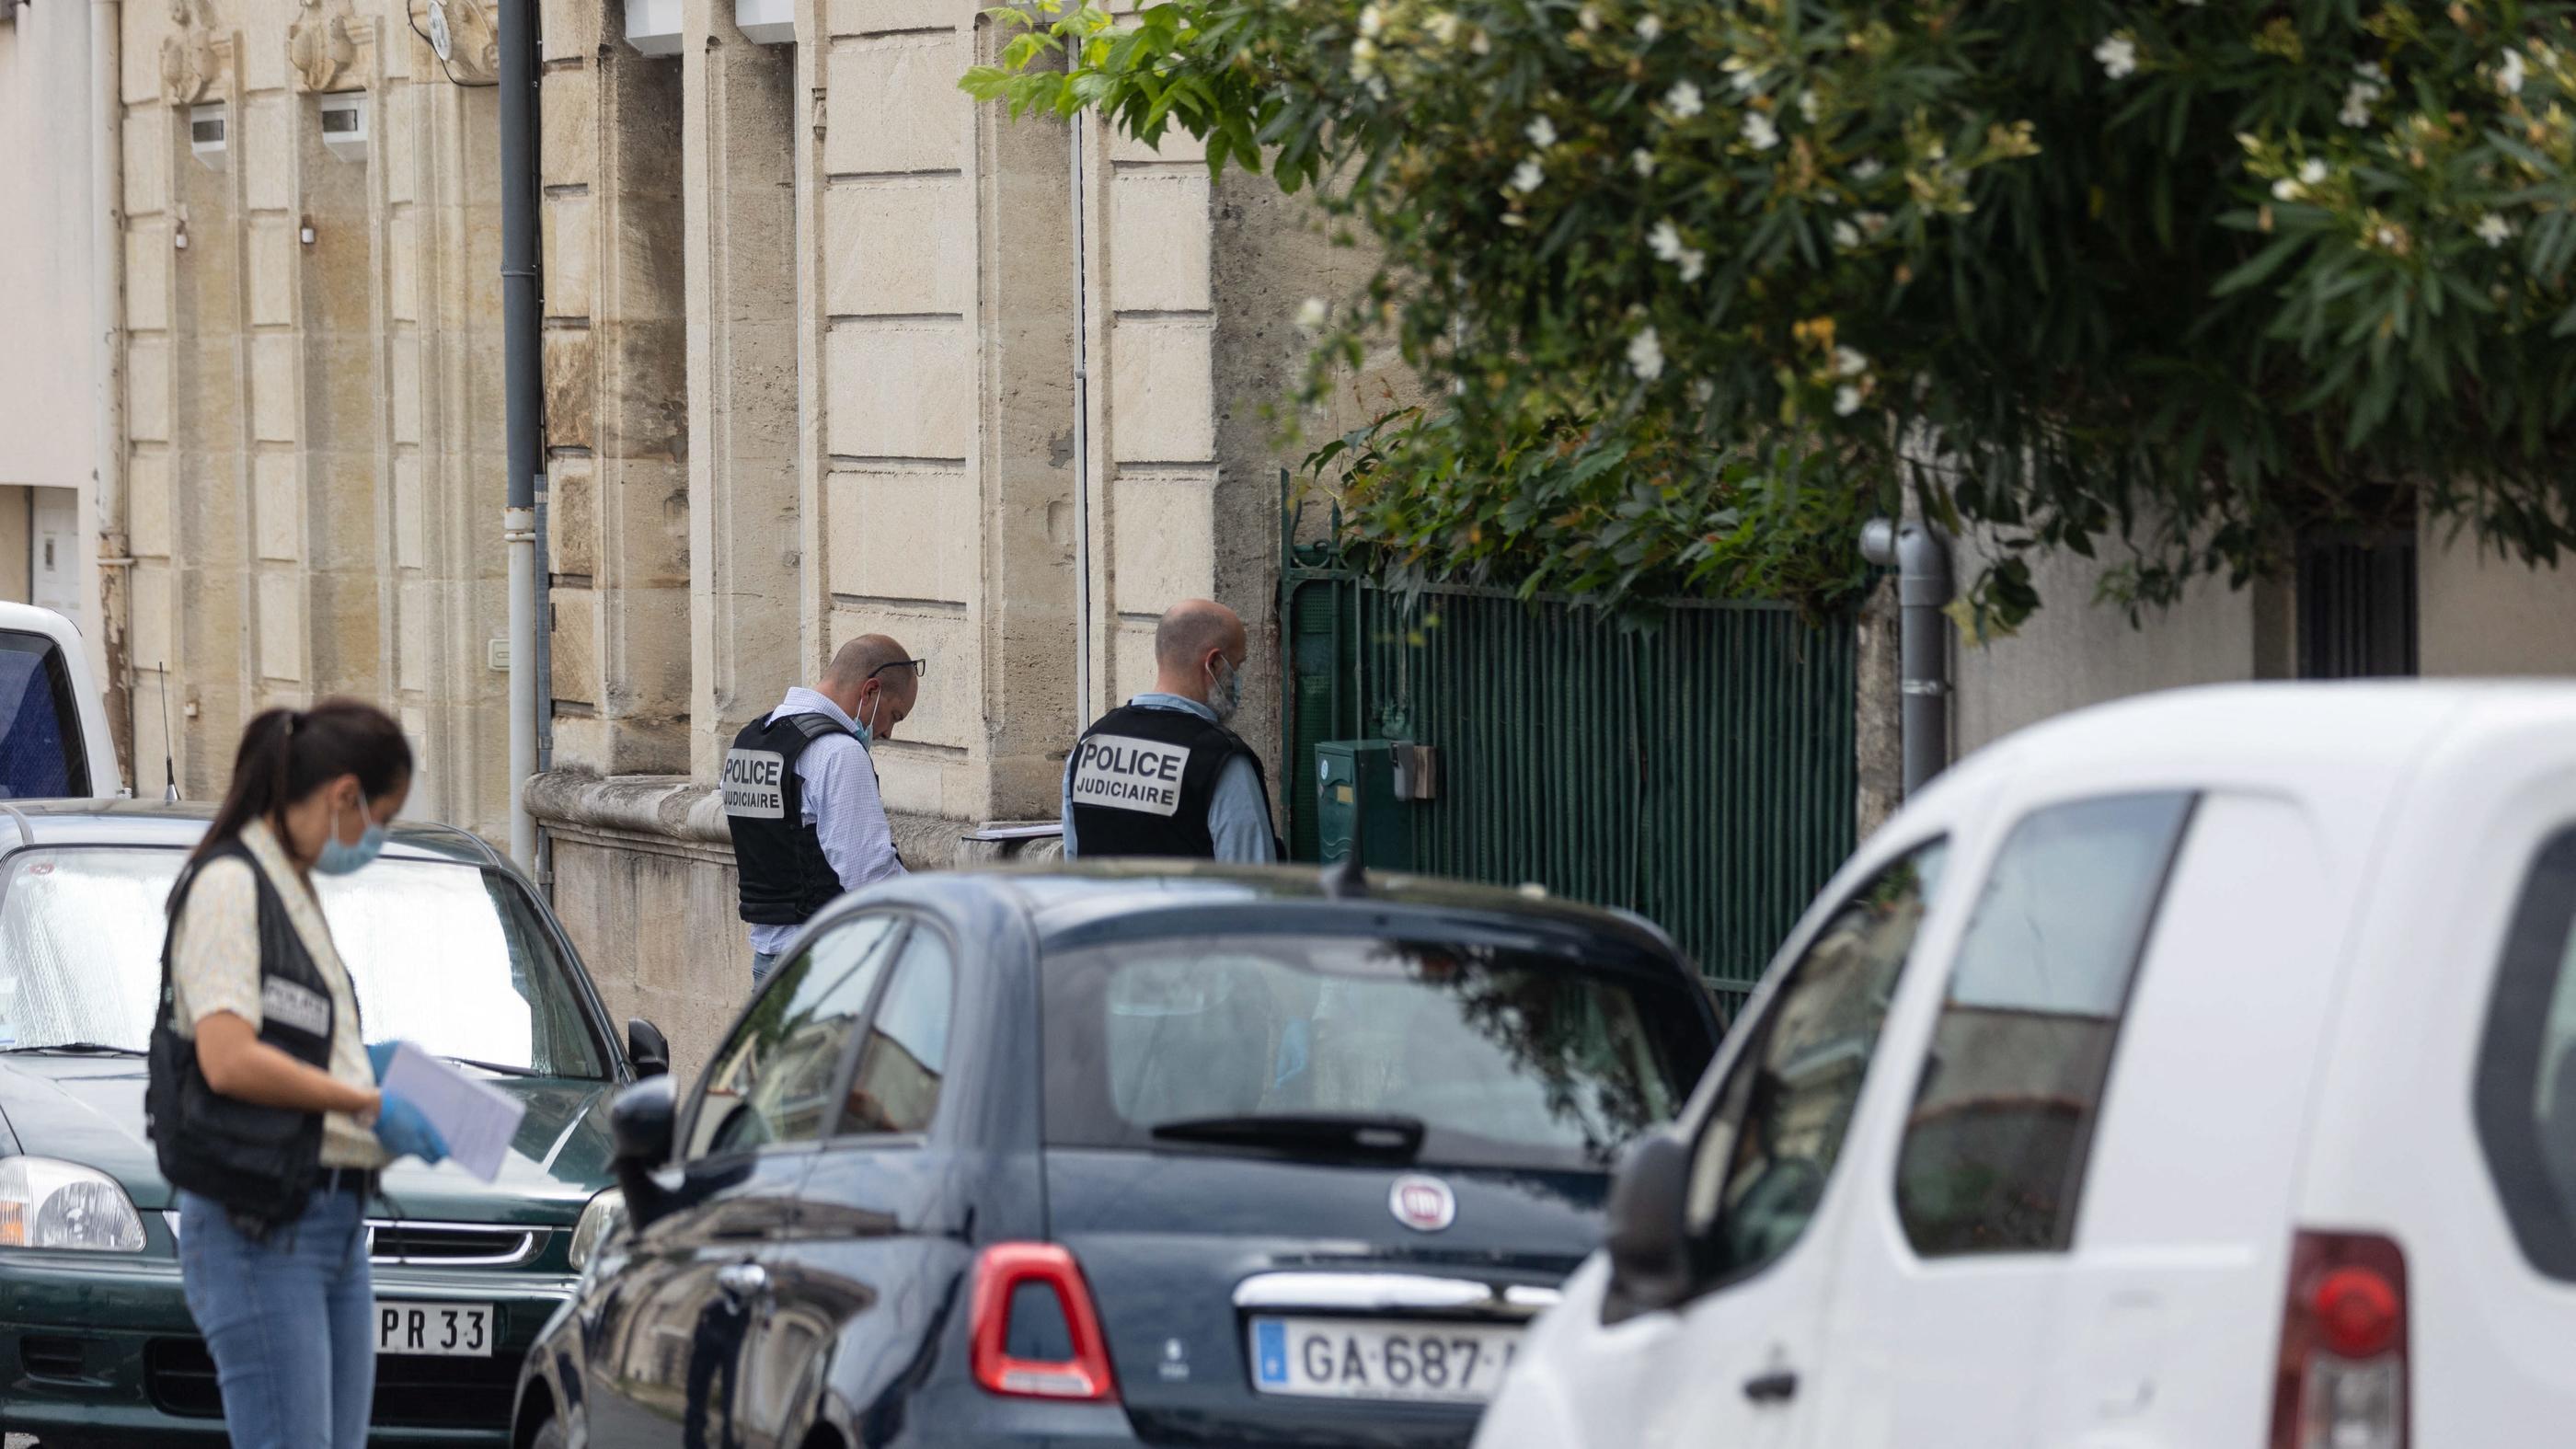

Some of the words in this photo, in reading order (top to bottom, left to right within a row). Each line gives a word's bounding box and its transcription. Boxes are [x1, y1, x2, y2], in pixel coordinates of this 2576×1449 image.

[724, 758, 779, 786] POLICE
[1082, 743, 1181, 782] POLICE
[724, 791, 779, 809] JUDICIAIRE
[1076, 777, 1174, 806] JUDICIAIRE
[382, 1309, 425, 1349] PR
[441, 1310, 484, 1350] 33
